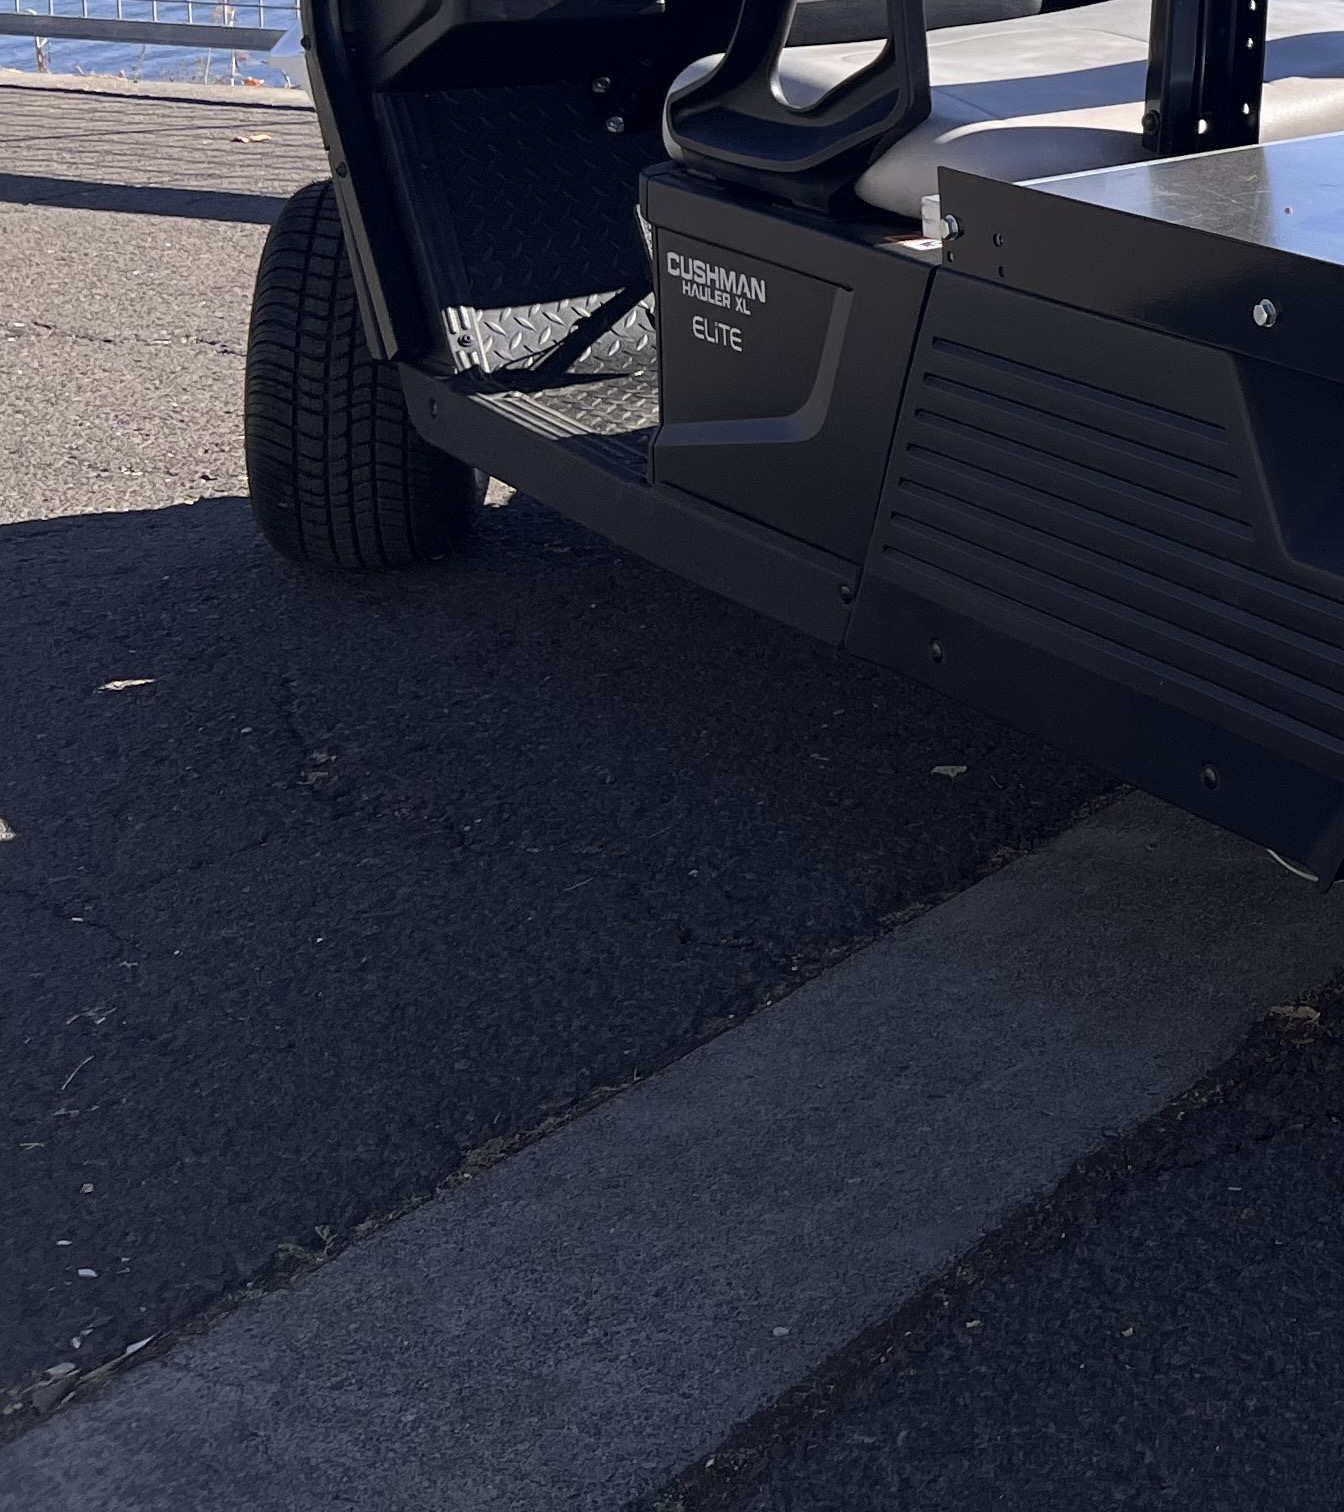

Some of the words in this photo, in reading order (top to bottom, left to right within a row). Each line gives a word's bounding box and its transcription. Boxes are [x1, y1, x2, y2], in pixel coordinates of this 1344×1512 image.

[667, 252, 766, 303] CUSHMAN
[682, 279, 731, 309] HAULER
[735, 297, 751, 315] XL
